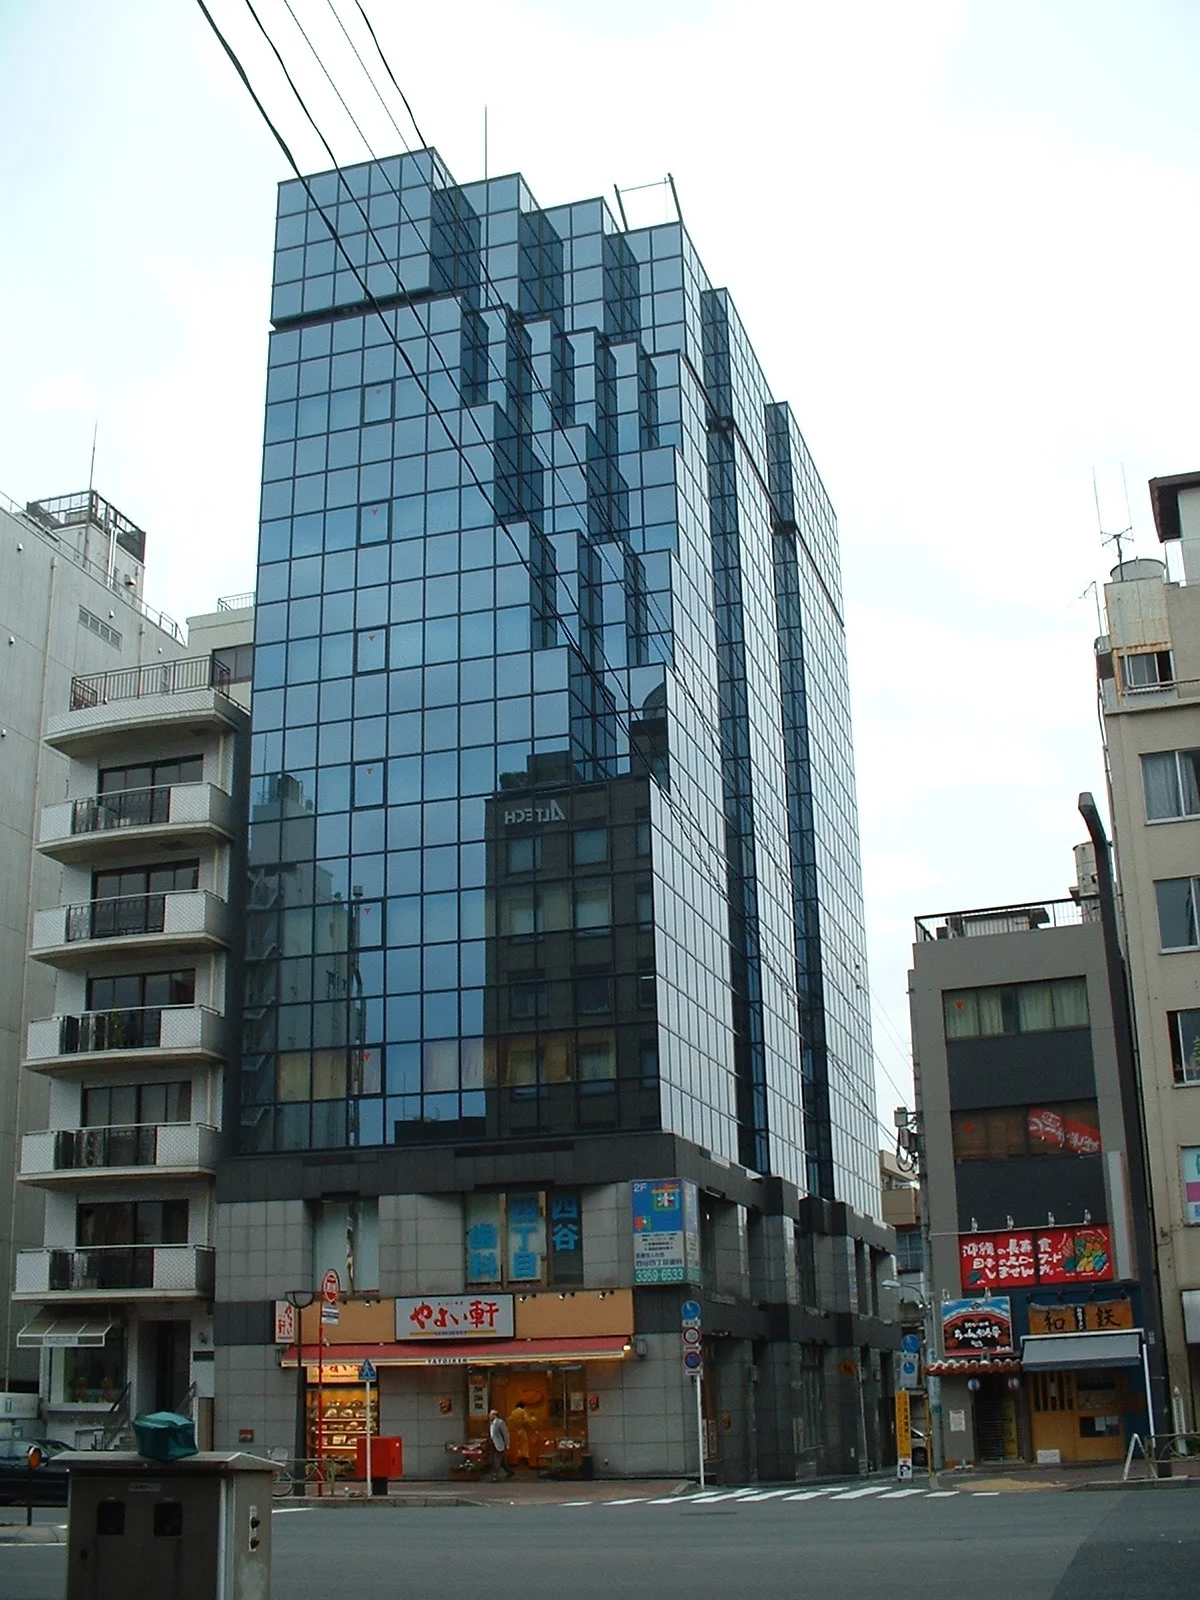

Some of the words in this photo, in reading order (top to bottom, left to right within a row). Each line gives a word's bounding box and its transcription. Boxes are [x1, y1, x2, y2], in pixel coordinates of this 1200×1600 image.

[633, 1183, 648, 1193] 2F
[409, 1299, 500, 1330] やよい軒
[1043, 1311, 1066, 1333] 和
